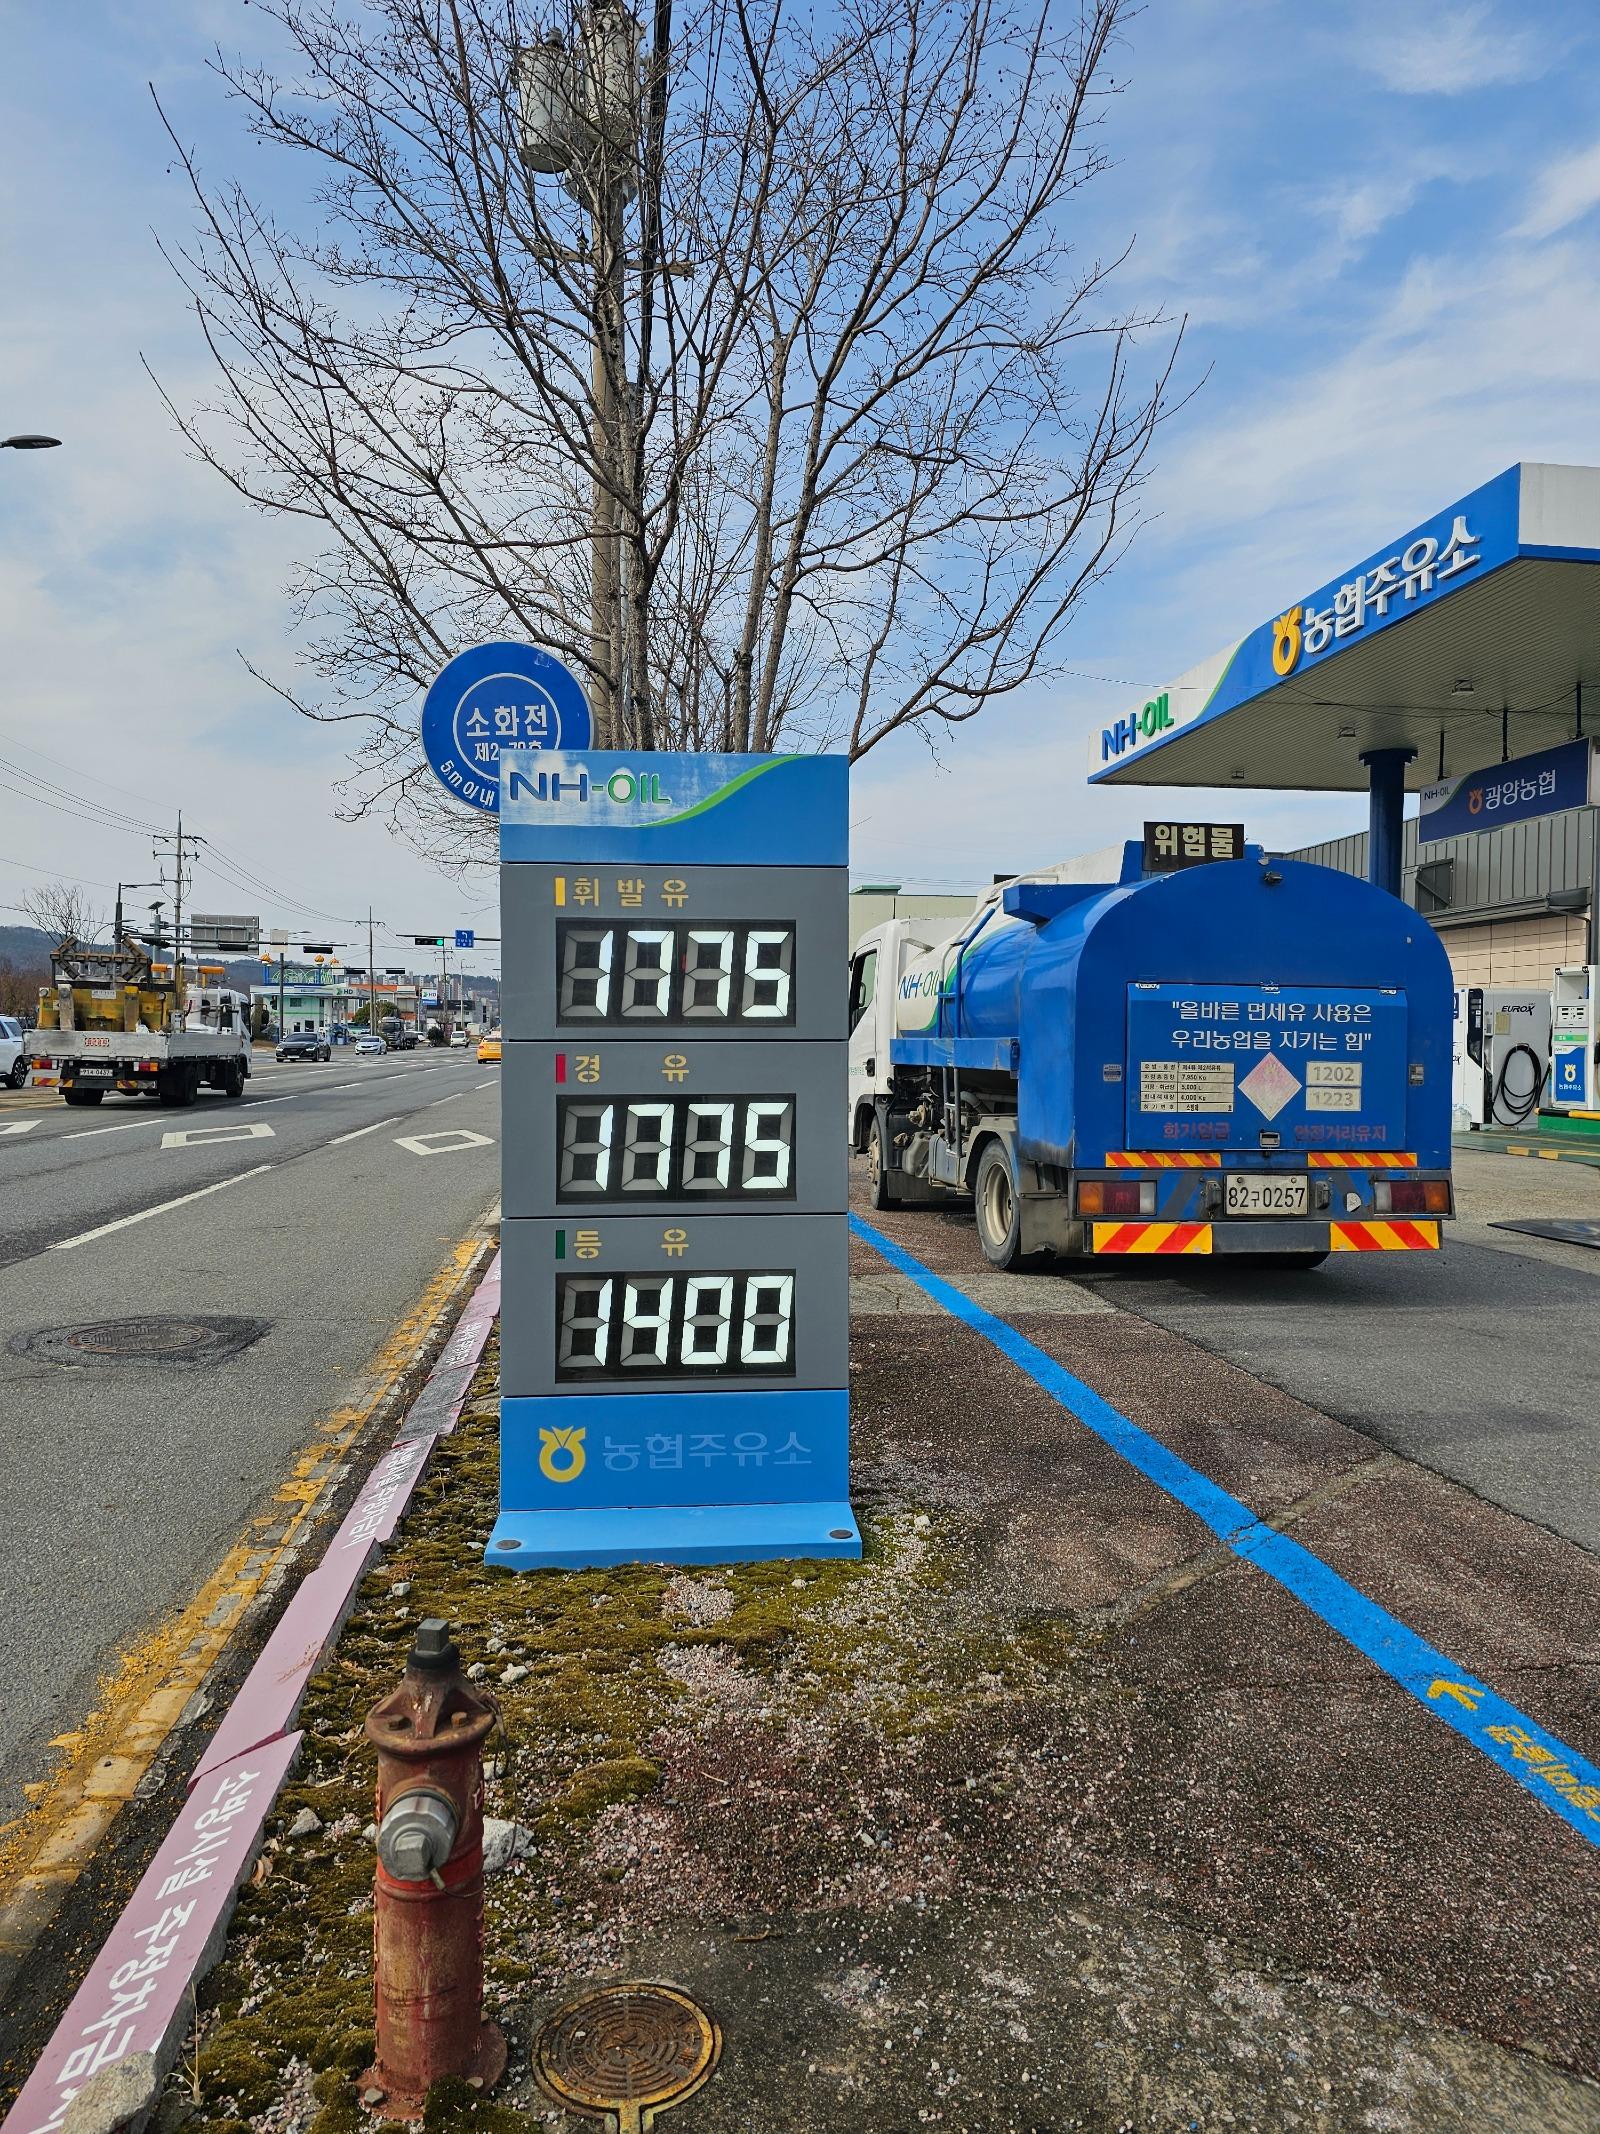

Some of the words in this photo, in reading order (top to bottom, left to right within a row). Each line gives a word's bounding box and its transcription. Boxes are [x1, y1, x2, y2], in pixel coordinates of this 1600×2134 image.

[1303, 516, 1481, 653] 농협주유소
[466, 704, 548, 737] 소화전
[1101, 693, 1175, 761] NH-OIL
[509, 771, 671, 804] NH-OIL
[1424, 787, 1450, 801] NH-OIL
[1485, 769, 1556, 811] 광양농협
[1154, 824, 1234, 859] 위험물
[594, 929, 792, 1018] 1775
[899, 970, 940, 1000] NH-OIL
[1247, 1002, 1307, 1022] 면세유
[1312, 1003, 1372, 1023] 사용은
[1501, 1004, 1536, 1016] EUROX
[1171, 1029, 1272, 1050] 우리농업을
[1279, 1030, 1338, 1051] 지키는
[1313, 1066, 1355, 1082] 1202
[1312, 1091, 1354, 1107] 1223
[594, 1102, 790, 1191] 1775
[1228, 1186, 1306, 1208] 82구0257
[593, 1275, 794, 1367] 1400
[602, 1430, 813, 1471] 농협주유소
[156, 1770, 261, 1901] 소방시설
